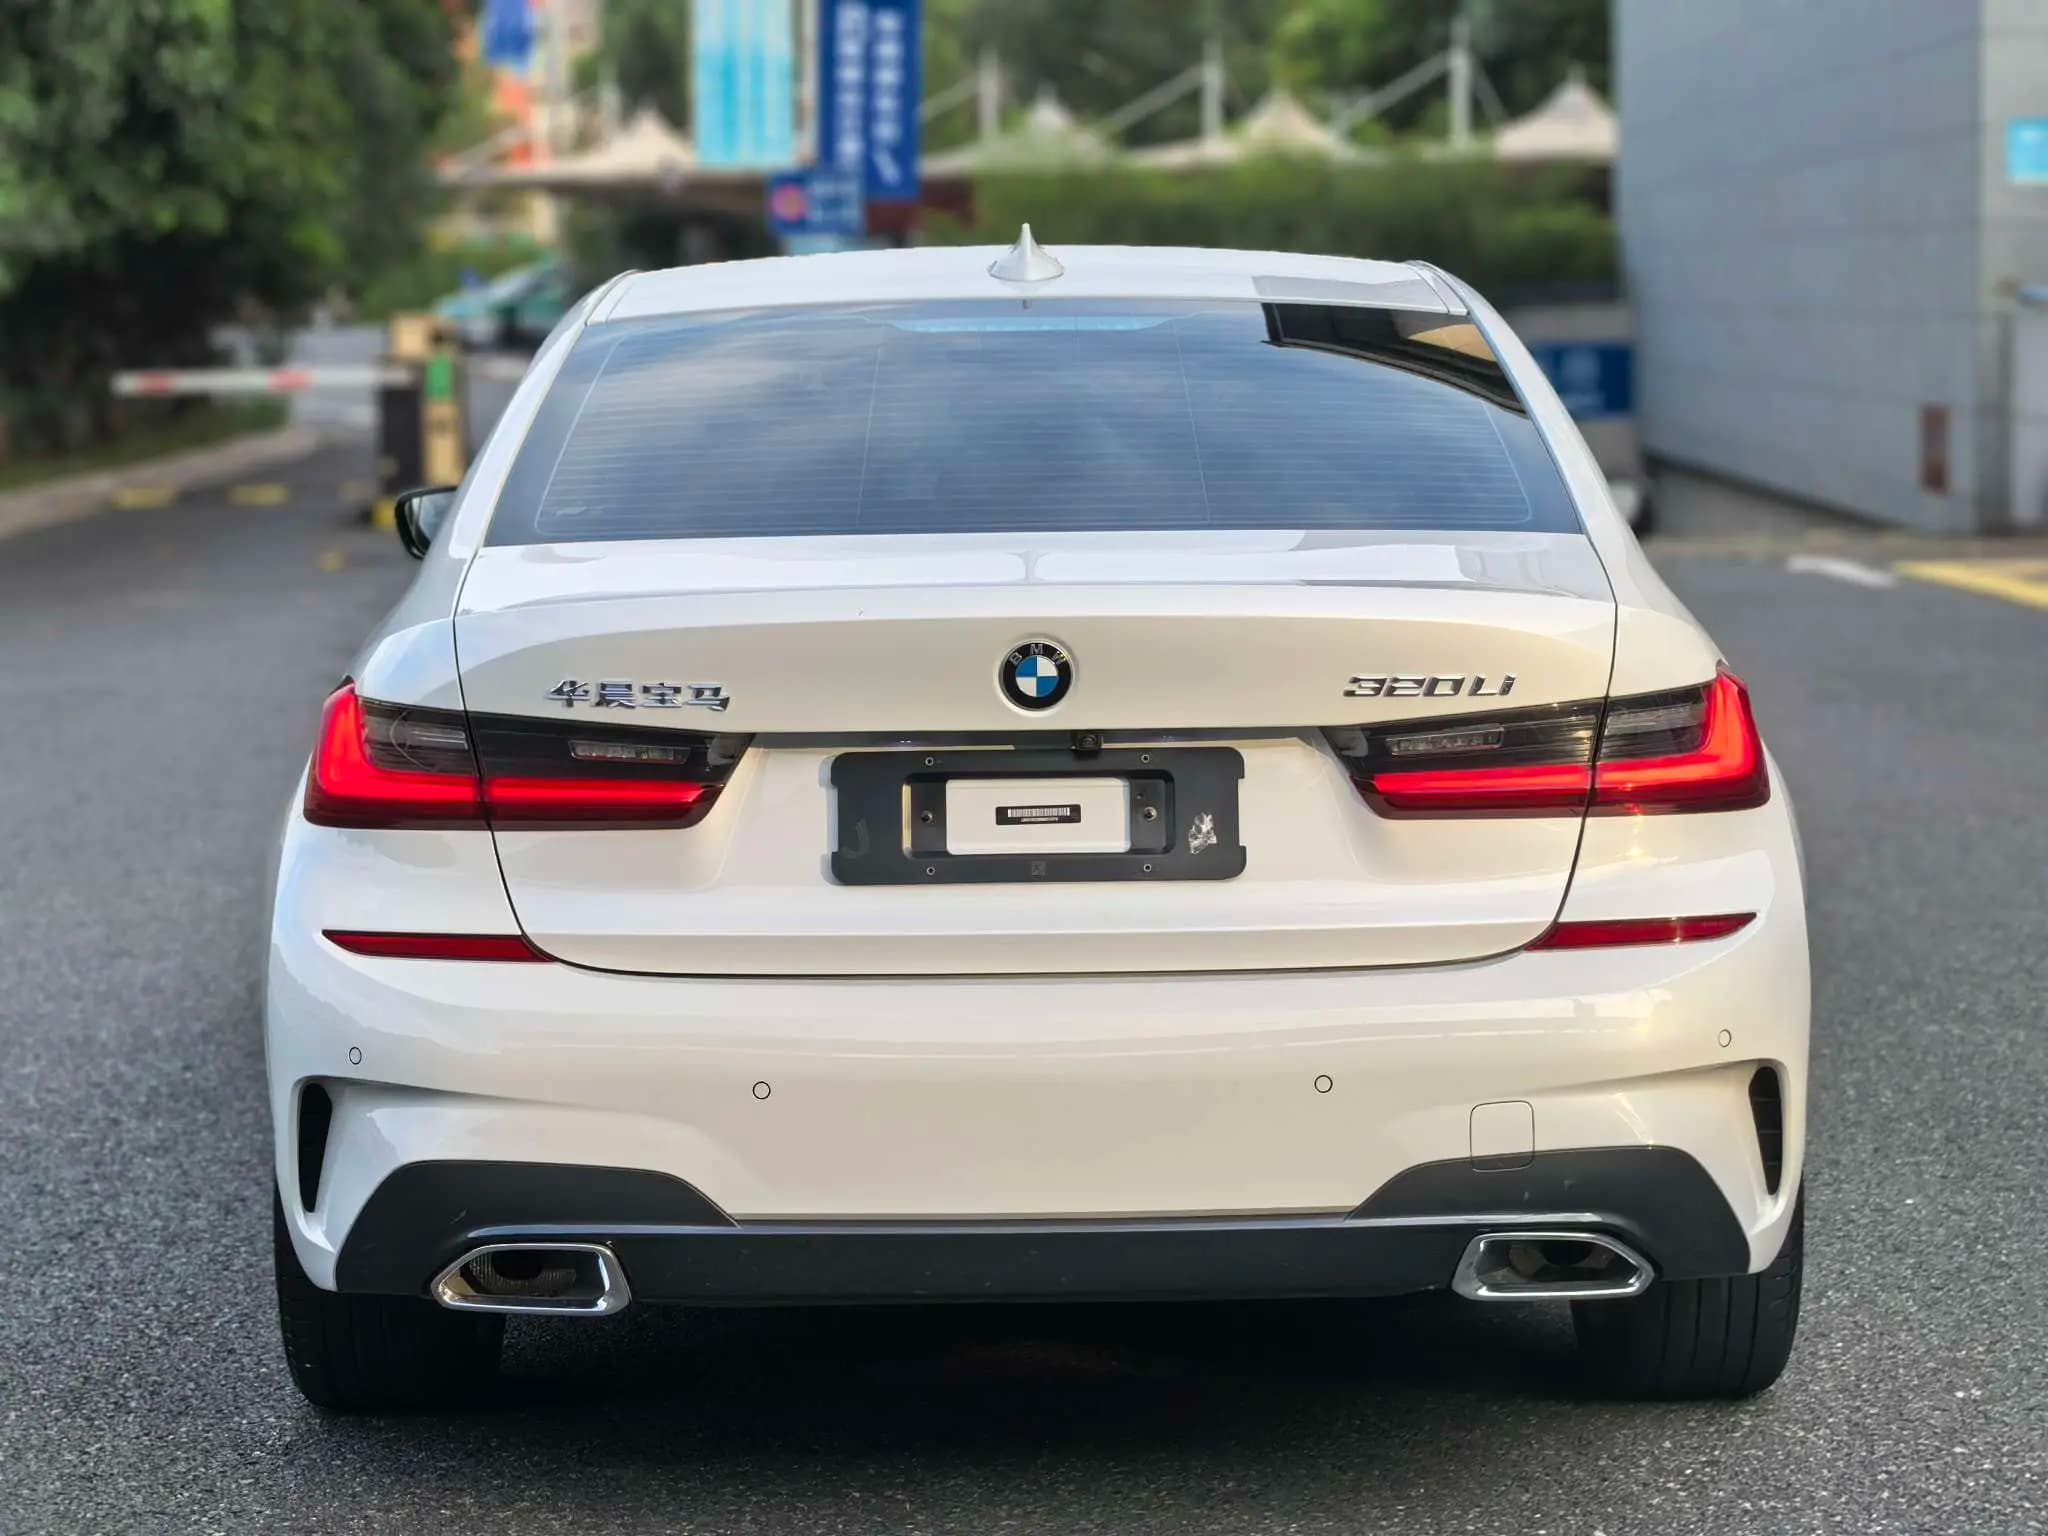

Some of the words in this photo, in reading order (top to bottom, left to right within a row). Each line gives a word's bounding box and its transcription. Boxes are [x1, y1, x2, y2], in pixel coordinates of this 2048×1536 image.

[1009, 643, 1066, 665] BMW
[544, 679, 730, 711] 华晨宝马
